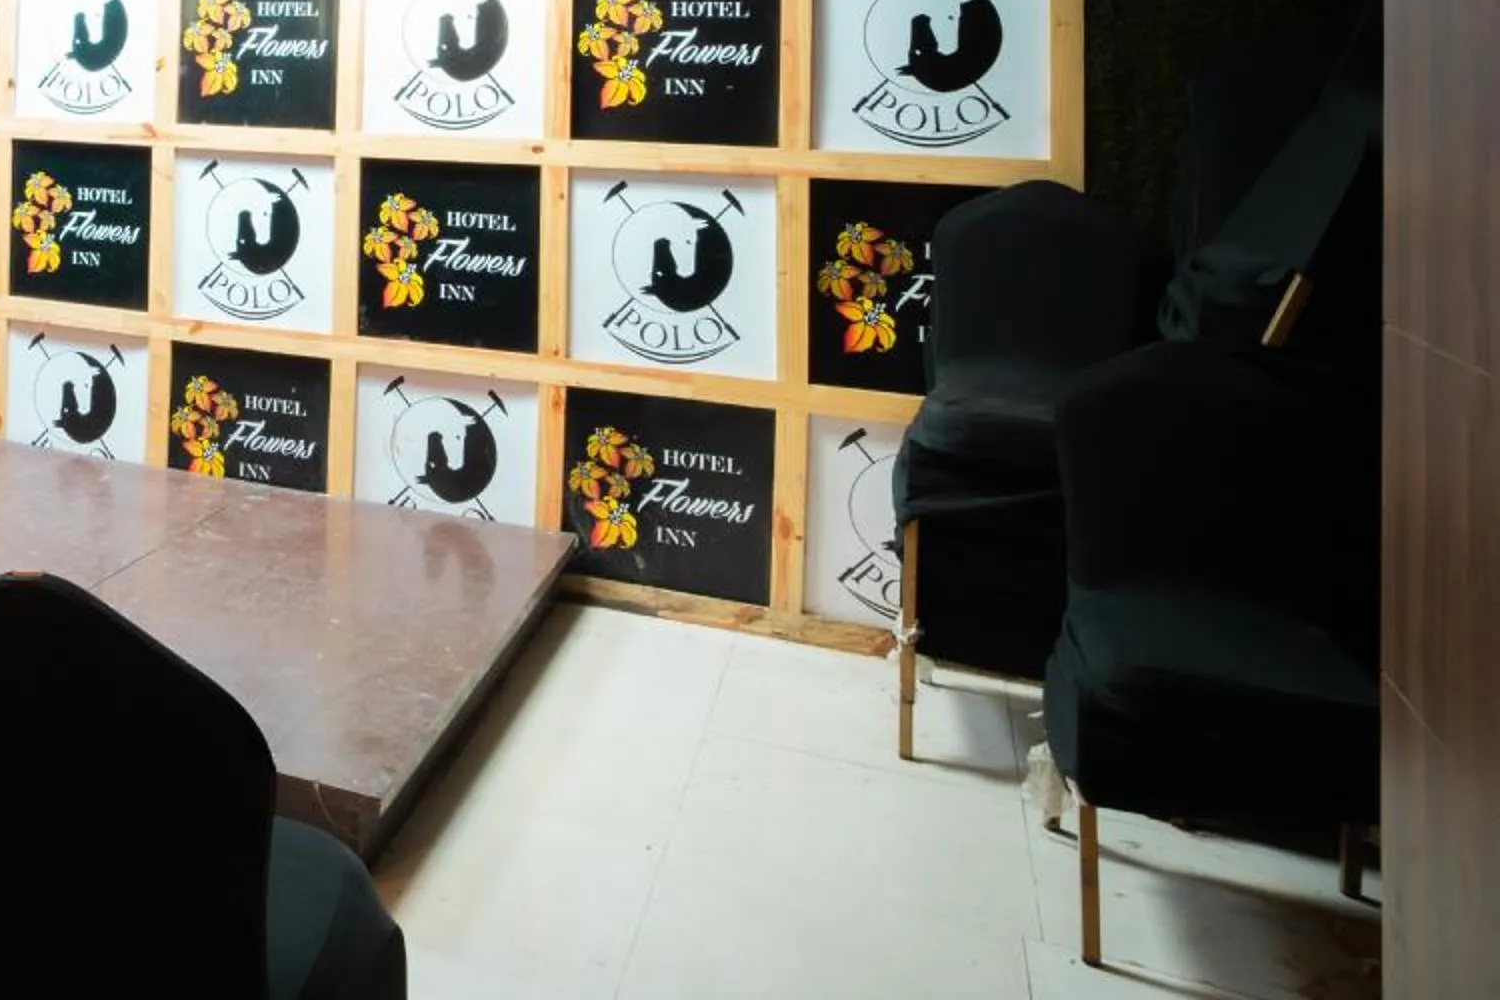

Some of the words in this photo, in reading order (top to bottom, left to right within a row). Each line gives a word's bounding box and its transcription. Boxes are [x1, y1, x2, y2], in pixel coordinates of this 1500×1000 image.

[257, 1, 321, 18] HOTEL
[671, 0, 750, 18] HOTEL
[235, 23, 329, 60] Flowers
[645, 26, 763, 68] Flowers
[47, 72, 120, 104] POLO
[251, 69, 284, 85] INN
[665, 77, 705, 96] INN
[406, 80, 500, 118] POLO
[868, 91, 990, 133] POLO
[77, 186, 133, 205] HOTEL
[59, 209, 141, 245] Flowers
[446, 210, 517, 232] HOTEL
[71, 250, 101, 267] INN
[422, 236, 526, 277] Flowers
[208, 271, 291, 309] POLO
[439, 283, 475, 301] INN
[616, 308, 723, 351] POLO
[244, 394, 307, 417] HOTEL
[223, 419, 316, 459] Flowers
[239, 461, 270, 481] INN
[663, 449, 742, 476] HOTEL
[637, 477, 755, 523] Flowers
[657, 527, 698, 548] INN
